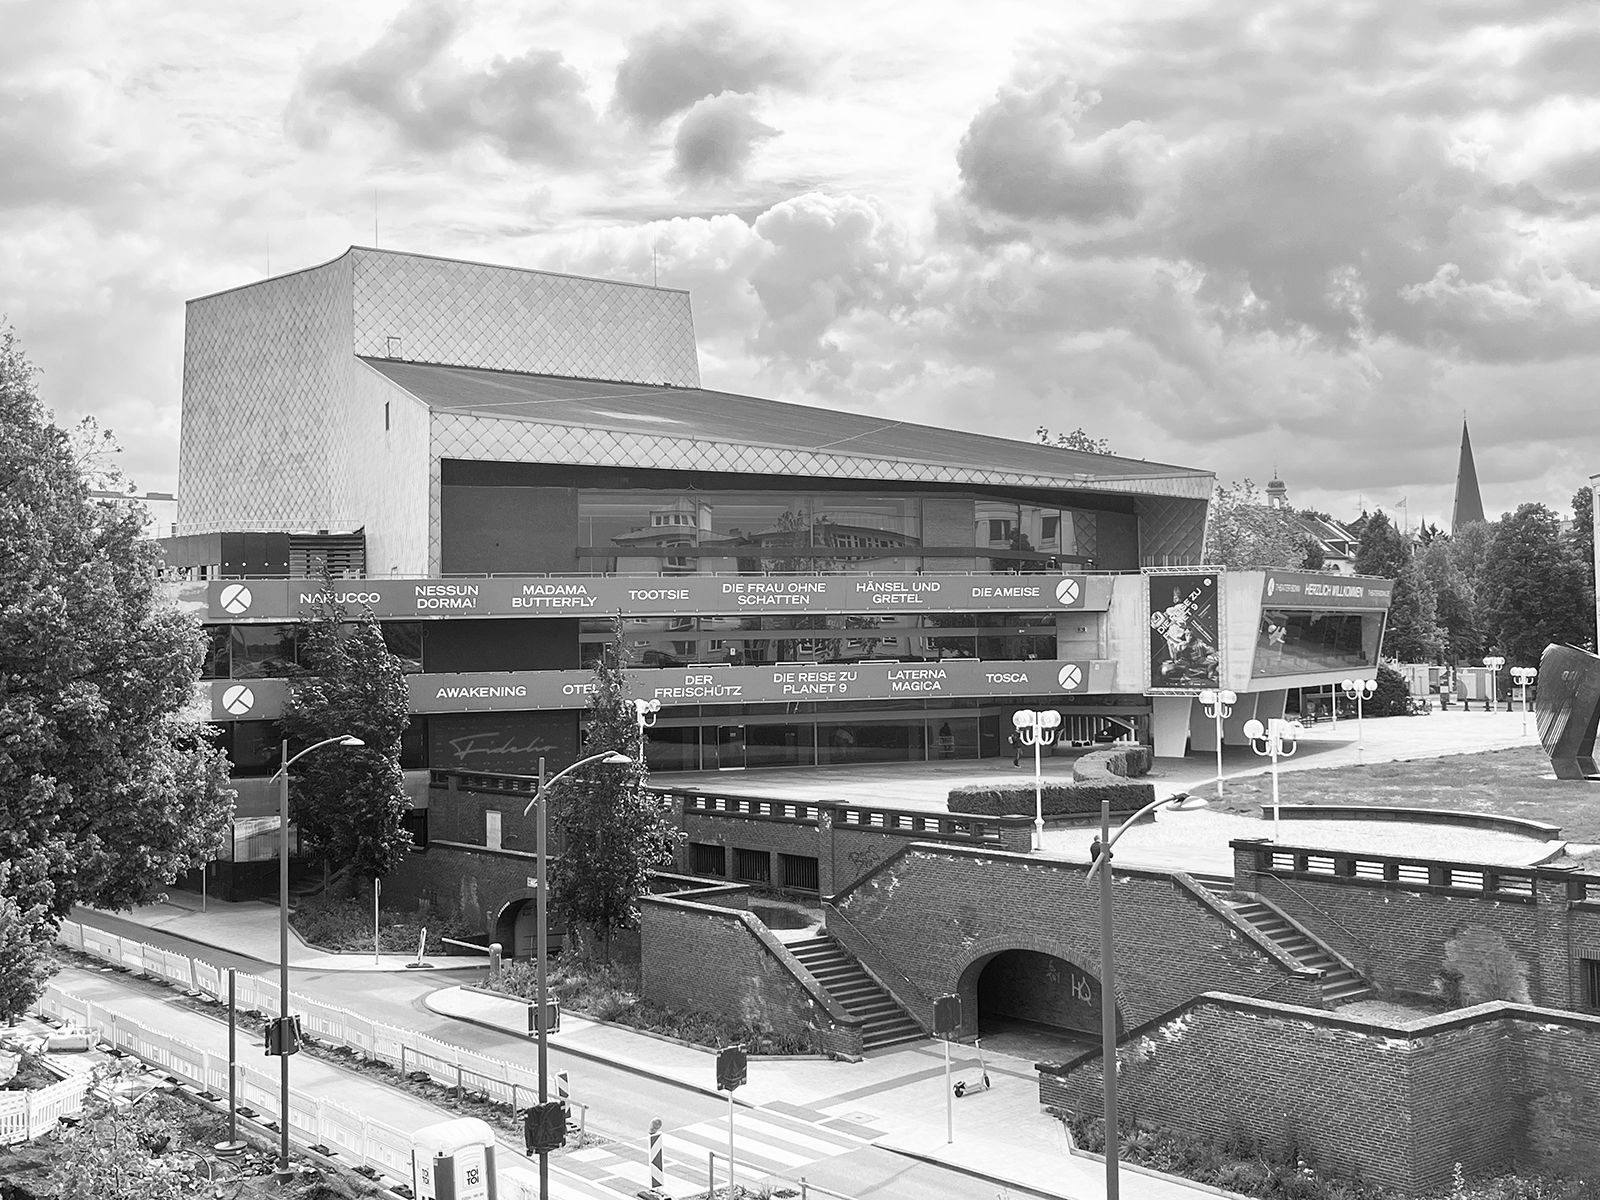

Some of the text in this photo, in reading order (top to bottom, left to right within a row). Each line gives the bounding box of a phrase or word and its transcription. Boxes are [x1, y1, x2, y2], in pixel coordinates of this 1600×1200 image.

[415, 585, 479, 596] NESSUN
[522, 585, 588, 595] MADAMA
[722, 582, 827, 593] DIE FRAU OHNE
[856, 581, 941, 592] HÄNSEL UND
[972, 587, 1040, 597] DIE AMEISE
[1304, 583, 1332, 597] HERZLICH
[628, 589, 690, 600] TOOTSIE
[737, 595, 810, 605] SCHATTEN
[872, 593, 924, 604] GRETEL
[416, 598, 477, 609] DORMA!
[511, 597, 598, 608] BUTTERFLY
[1190, 603, 1199, 611] 9
[1156, 619, 1172, 634] DIE
[1188, 587, 1202, 601] ZU
[684, 675, 713, 685] DER
[773, 671, 858, 683] DIE REISE ZU
[887, 669, 947, 680] LATERNA
[985, 673, 1029, 683] TOSCA
[436, 685, 527, 698] AWAKENING
[654, 684, 743, 698] FREISCHÜTZ
[783, 683, 848, 694] PLANET 9
[892, 681, 942, 691] MAGICA
